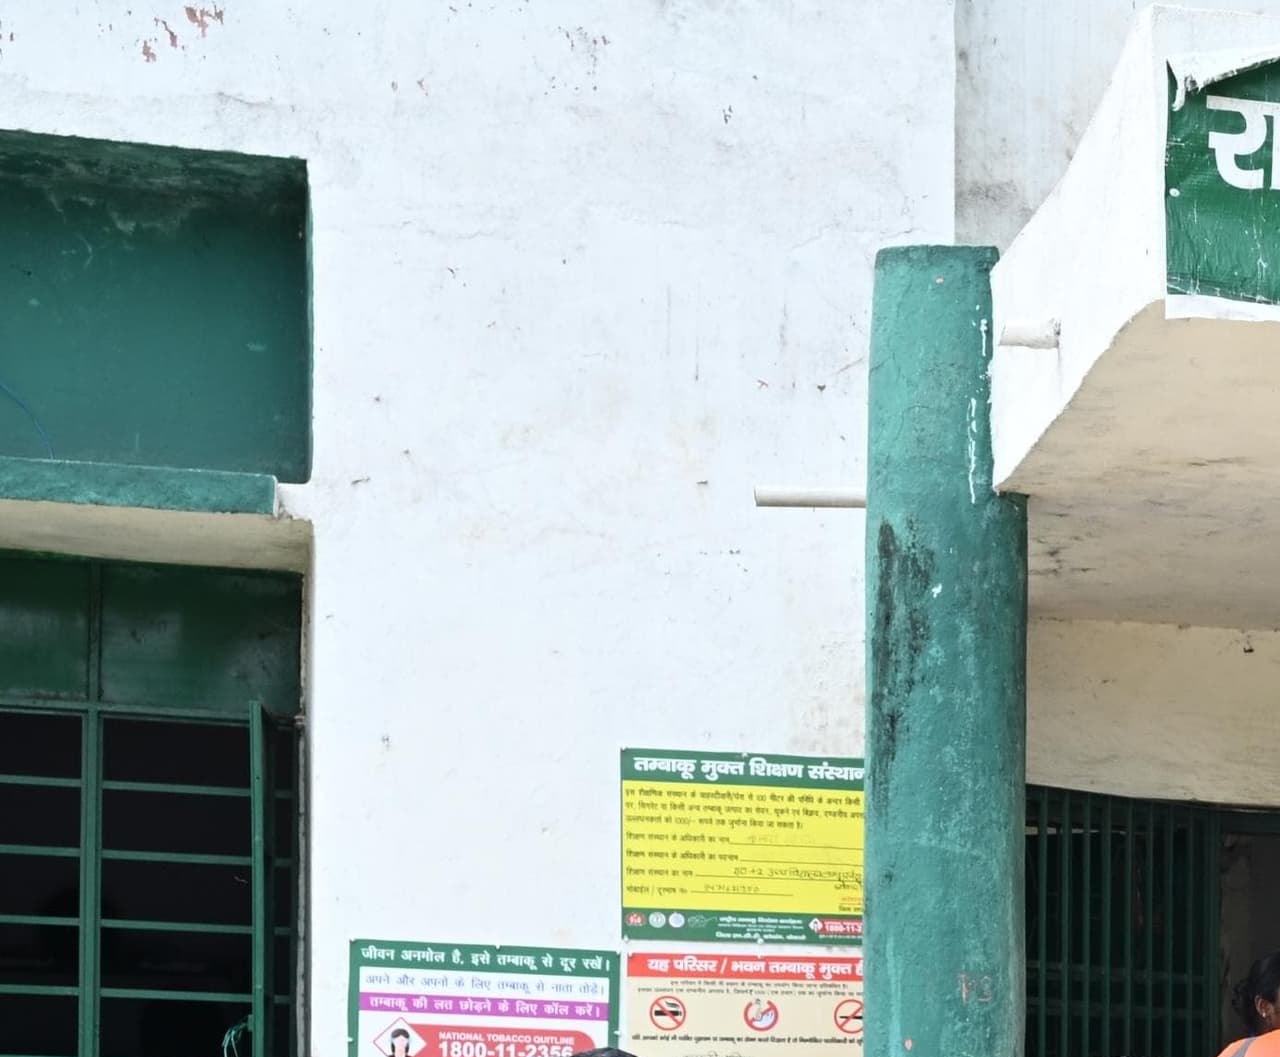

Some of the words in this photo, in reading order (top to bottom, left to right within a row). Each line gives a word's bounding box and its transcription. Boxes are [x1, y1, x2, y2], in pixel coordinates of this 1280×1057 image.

[634, 757, 697, 779] तम्बाकू
[701, 760, 744, 780] मुक्त
[749, 757, 803, 778] शिक्षण
[647, 957, 669, 972] यह
[674, 956, 718, 972] परिसर
[731, 960, 765, 973] भवन
[769, 961, 815, 979] तम्बाकू
[819, 962, 851, 979] मुक्त
[439, 1032, 484, 1043] NATIONAL
[487, 1034, 532, 1044] TOBACCO
[533, 1036, 575, 1045] QUITLINE
